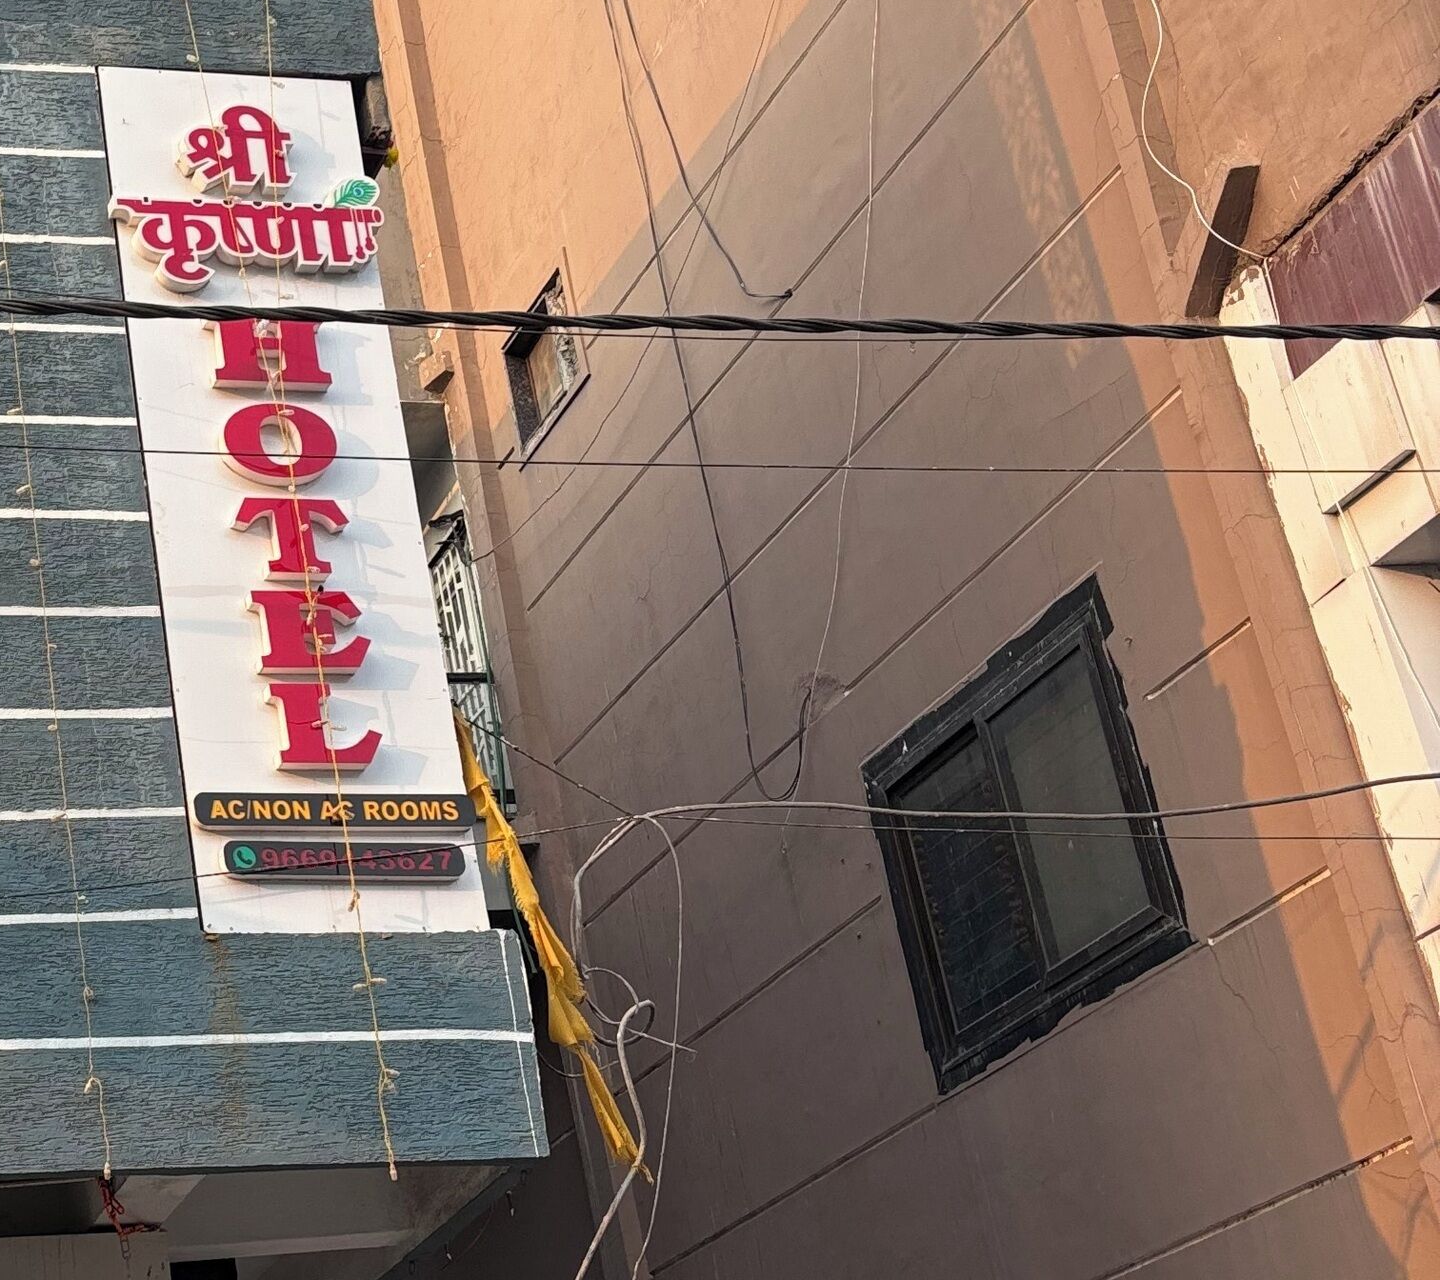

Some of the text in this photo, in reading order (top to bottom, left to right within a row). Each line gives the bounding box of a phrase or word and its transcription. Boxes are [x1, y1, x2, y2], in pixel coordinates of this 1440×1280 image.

[187, 105, 292, 184] श्री
[116, 197, 382, 281] कृष्णा
[208, 317, 384, 770] HOTEL
[210, 799, 460, 822] AC/NON AC ROOMS
